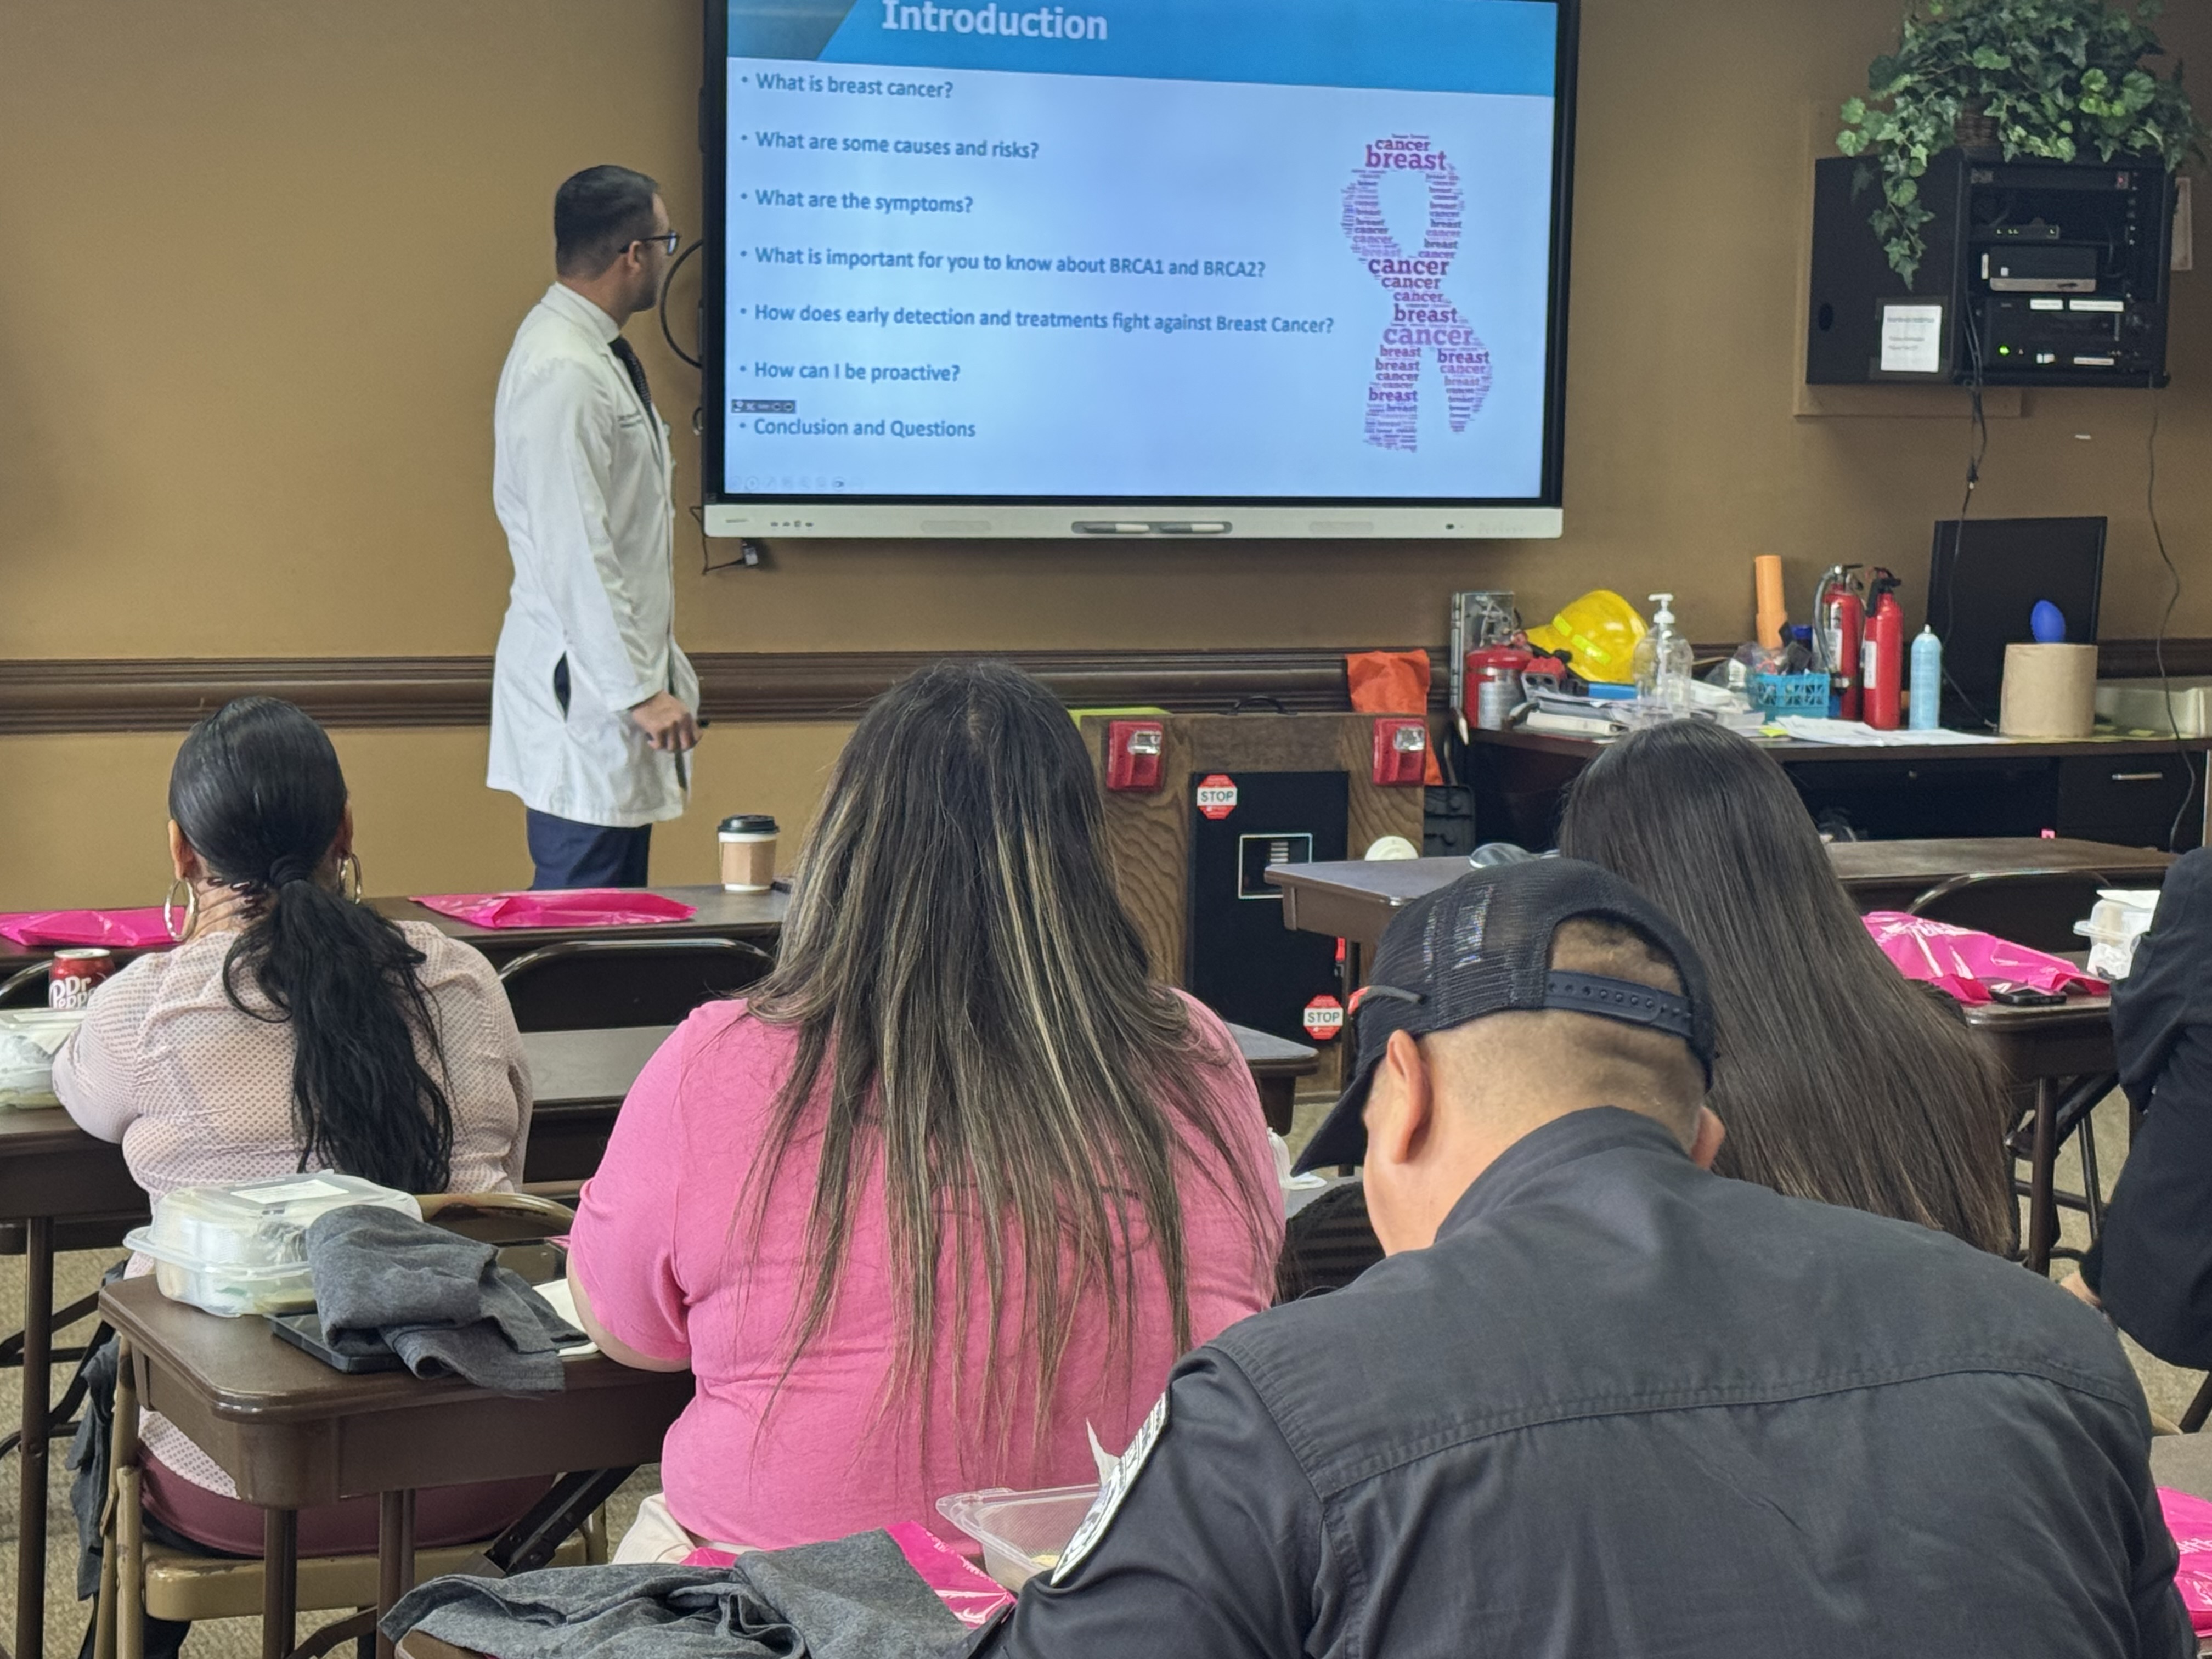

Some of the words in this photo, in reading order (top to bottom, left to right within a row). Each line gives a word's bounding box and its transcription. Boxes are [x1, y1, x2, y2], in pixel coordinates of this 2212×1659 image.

[882, 0, 1108, 41] Introduction
[756, 73, 803, 91] What
[809, 75, 823, 92] is
[828, 76, 882, 95] breast
[887, 81, 953, 99] cancer?
[756, 132, 803, 149] What
[809, 137, 837, 150] are
[842, 138, 889, 153] some
[894, 140, 951, 155] causes
[956, 140, 986, 156] and
[991, 141, 1039, 159] risks?
[1375, 139, 1431, 151] cancer
[1365, 144, 1447, 171] breast
[756, 189, 803, 207] What
[808, 195, 837, 208] are
[841, 193, 871, 210] the
[875, 196, 973, 215] symptoms?
[755, 247, 803, 264] What
[808, 249, 821, 265] is
[826, 249, 914, 270] important
[918, 251, 944, 268] for
[946, 255, 979, 272] you
[984, 255, 1001, 270] to
[1006, 255, 1051, 272] know
[1056, 256, 1105, 274] about
[1109, 258, 1164, 275] BRCA1
[1169, 260, 1198, 276] and
[1204, 261, 1266, 278] BRCA2?
[1368, 258, 1450, 275] cancer
[1381, 276, 1442, 289] cancer
[1393, 292, 1444, 302] cancer
[754, 304, 795, 321] How
[799, 305, 841, 322] does
[846, 307, 889, 327] early
[894, 307, 975, 325] detection
[979, 311, 1011, 326] and
[1016, 312, 1108, 329] treatments
[1112, 312, 1149, 333] fight
[1154, 314, 1212, 334] against
[1216, 315, 1267, 332] Breast
[1271, 317, 1334, 334] Cancer?
[1393, 303, 1458, 323] breast
[1383, 328, 1474, 346] cancer
[1380, 345, 1421, 357] breast
[1437, 348, 1490, 364] breast
[754, 362, 794, 378] How
[799, 365, 829, 379] can
[833, 364, 839, 379] I
[844, 362, 866, 380] be
[871, 364, 961, 384] proactive?
[1375, 358, 1420, 371] breast
[1440, 365, 1486, 374] cancer
[1376, 373, 1419, 382] cancer
[1368, 387, 1418, 402] breast
[754, 418, 848, 436] Conclusion
[853, 420, 885, 436] and
[890, 420, 976, 439] Questions
[1201, 791, 1234, 802] STOP
[49, 980, 97, 1009] Pepp
[65, 976, 92, 995] Dr
[1307, 1012, 1340, 1023] STOP
